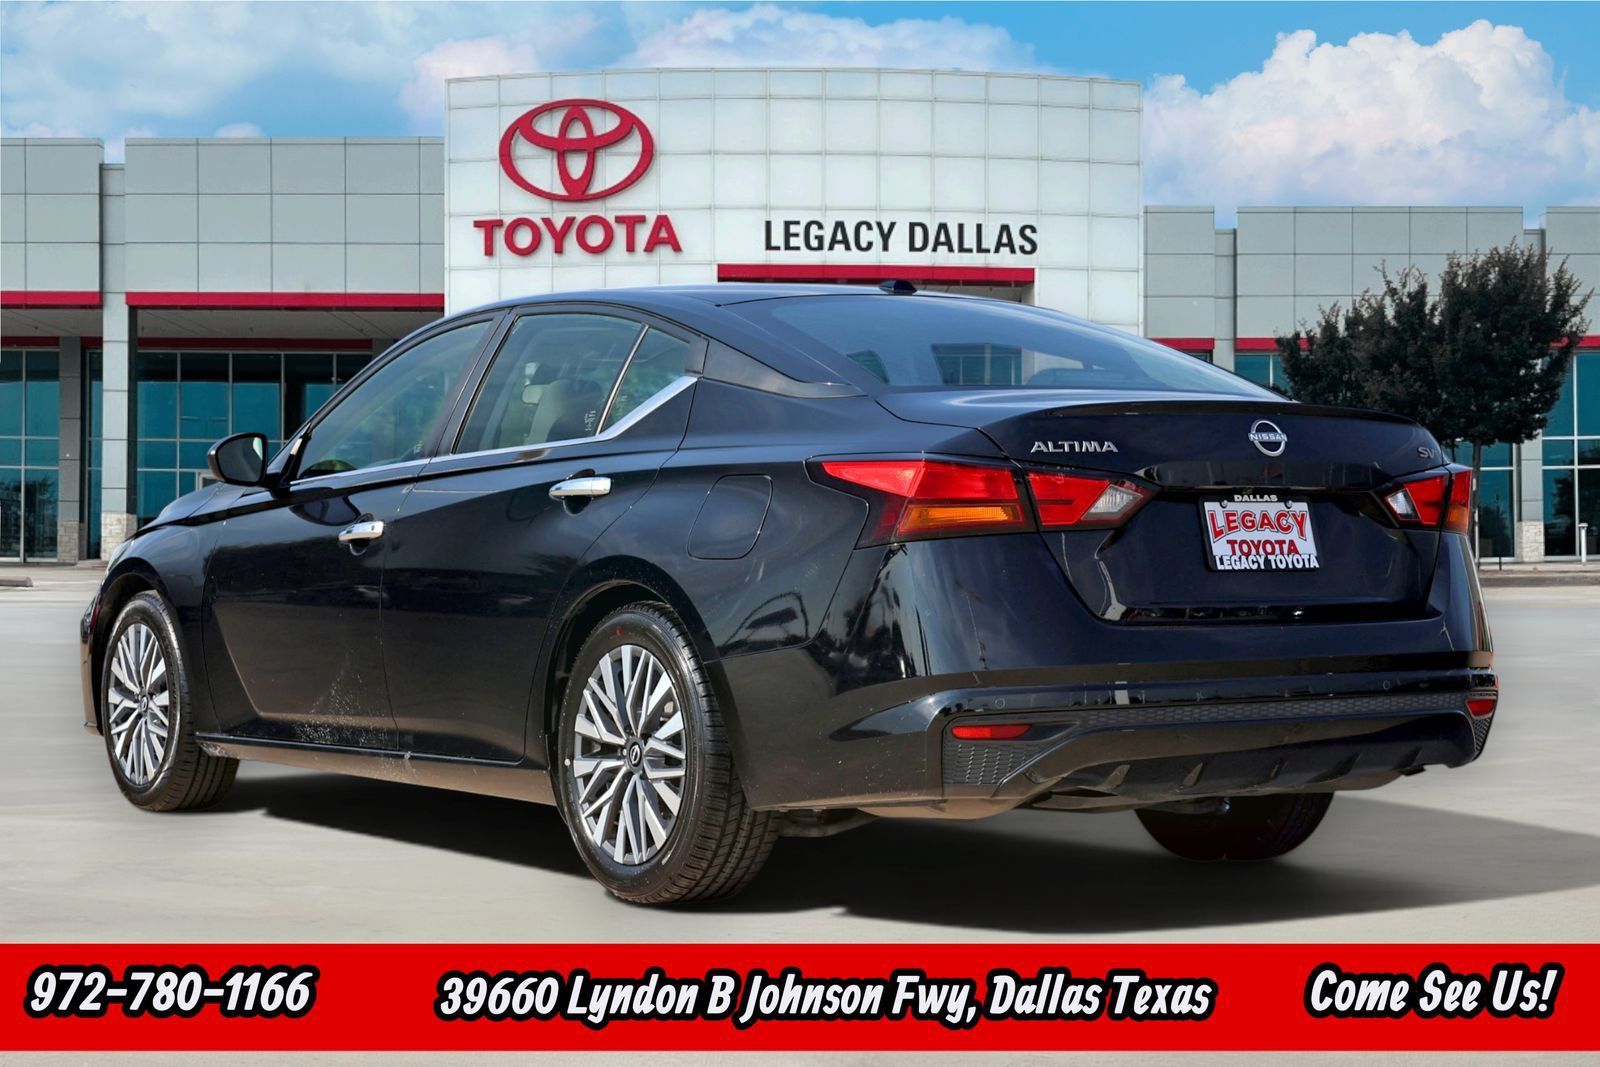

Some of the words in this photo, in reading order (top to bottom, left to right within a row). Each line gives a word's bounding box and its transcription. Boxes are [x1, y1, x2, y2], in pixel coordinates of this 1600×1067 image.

[473, 213, 682, 257] TOYOTA
[764, 219, 897, 253] LEGACY
[907, 221, 1038, 255] DALLAS
[1248, 432, 1288, 442] NISSAN
[1030, 440, 1119, 453] ALTIMA
[1416, 447, 1435, 459] SV
[1233, 494, 1278, 502] DALLAS
[1207, 509, 1307, 542] LEGACY
[1225, 539, 1300, 556] TOYOTA
[1215, 554, 1266, 571] LEGACY
[1268, 553, 1320, 570] TOYOTA
